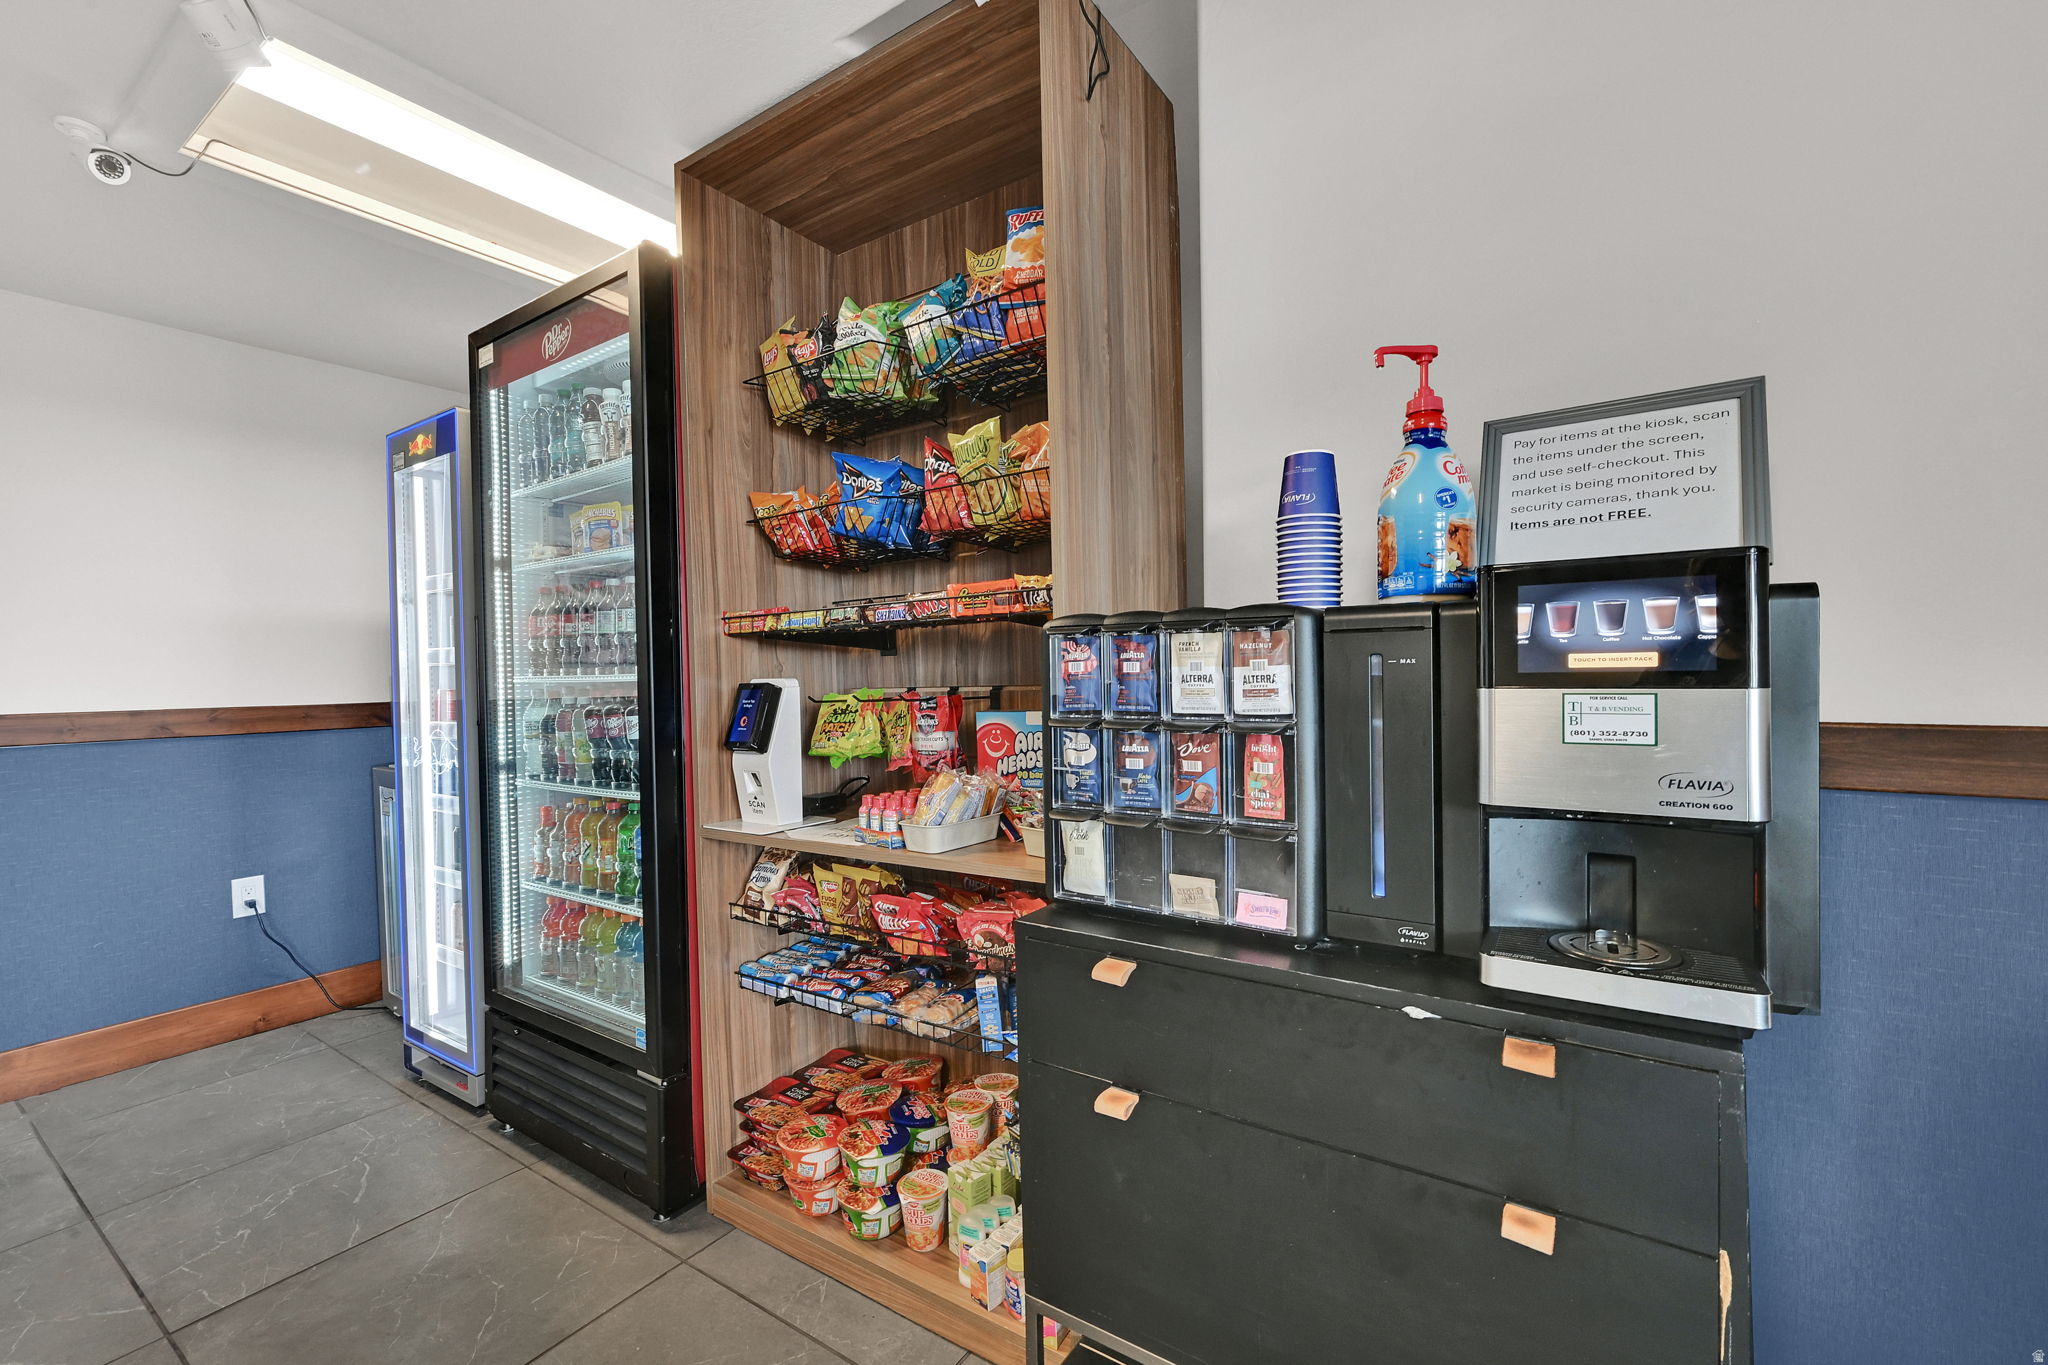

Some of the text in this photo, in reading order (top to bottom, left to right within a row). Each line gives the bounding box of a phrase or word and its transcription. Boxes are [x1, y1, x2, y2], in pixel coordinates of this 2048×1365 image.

[552, 323, 563, 339] Dr
[543, 325, 570, 360] Pepper
[1514, 410, 1730, 449] Pay for items at the kiosk, scan
[1513, 432, 1704, 465] the items under the screen,
[1512, 448, 1705, 481] and use self-checkout. This
[842, 472, 884, 493] Doritos
[1511, 465, 1718, 498] market is being monitored by
[1284, 493, 1311, 503] FLAVIA
[1510, 485, 1716, 514] security cameras, thank you.
[1510, 508, 1652, 531] Items are not FREE.
[875, 604, 908, 623] SNICKERS
[1239, 642, 1273, 650] HAZELNUT
[1181, 674, 1214, 685] ALTERRA
[1242, 673, 1278, 686] ALTERRA
[1568, 701, 1580, 712] T
[826, 712, 857, 723] SOUR
[1569, 715, 1579, 726] B
[821, 722, 855, 733] PATCH
[1598, 730, 1649, 738] 352-8730
[1121, 743, 1149, 753] LAVAZZA
[1177, 742, 1212, 757] Dove
[1251, 743, 1277, 754] bright
[997, 750, 1043, 776] HEADS
[1017, 771, 1043, 779] 90 bar
[1667, 779, 1725, 792] FLAVIA
[1250, 788, 1270, 799] chai
[748, 800, 766, 809] SCAN
[1250, 798, 1275, 809] spice
[1658, 800, 1734, 811] CREATION 600
[754, 862, 780, 876] Famous
[1401, 929, 1426, 938] FLAVIA
[842, 1060, 860, 1068] MEIN
[847, 1057, 864, 1065] CHOW
[785, 1091, 804, 1100] MEIN
[791, 1087, 809, 1096] CHOW
[953, 1124, 971, 1133] CUP
[906, 1208, 925, 1218] CUP
